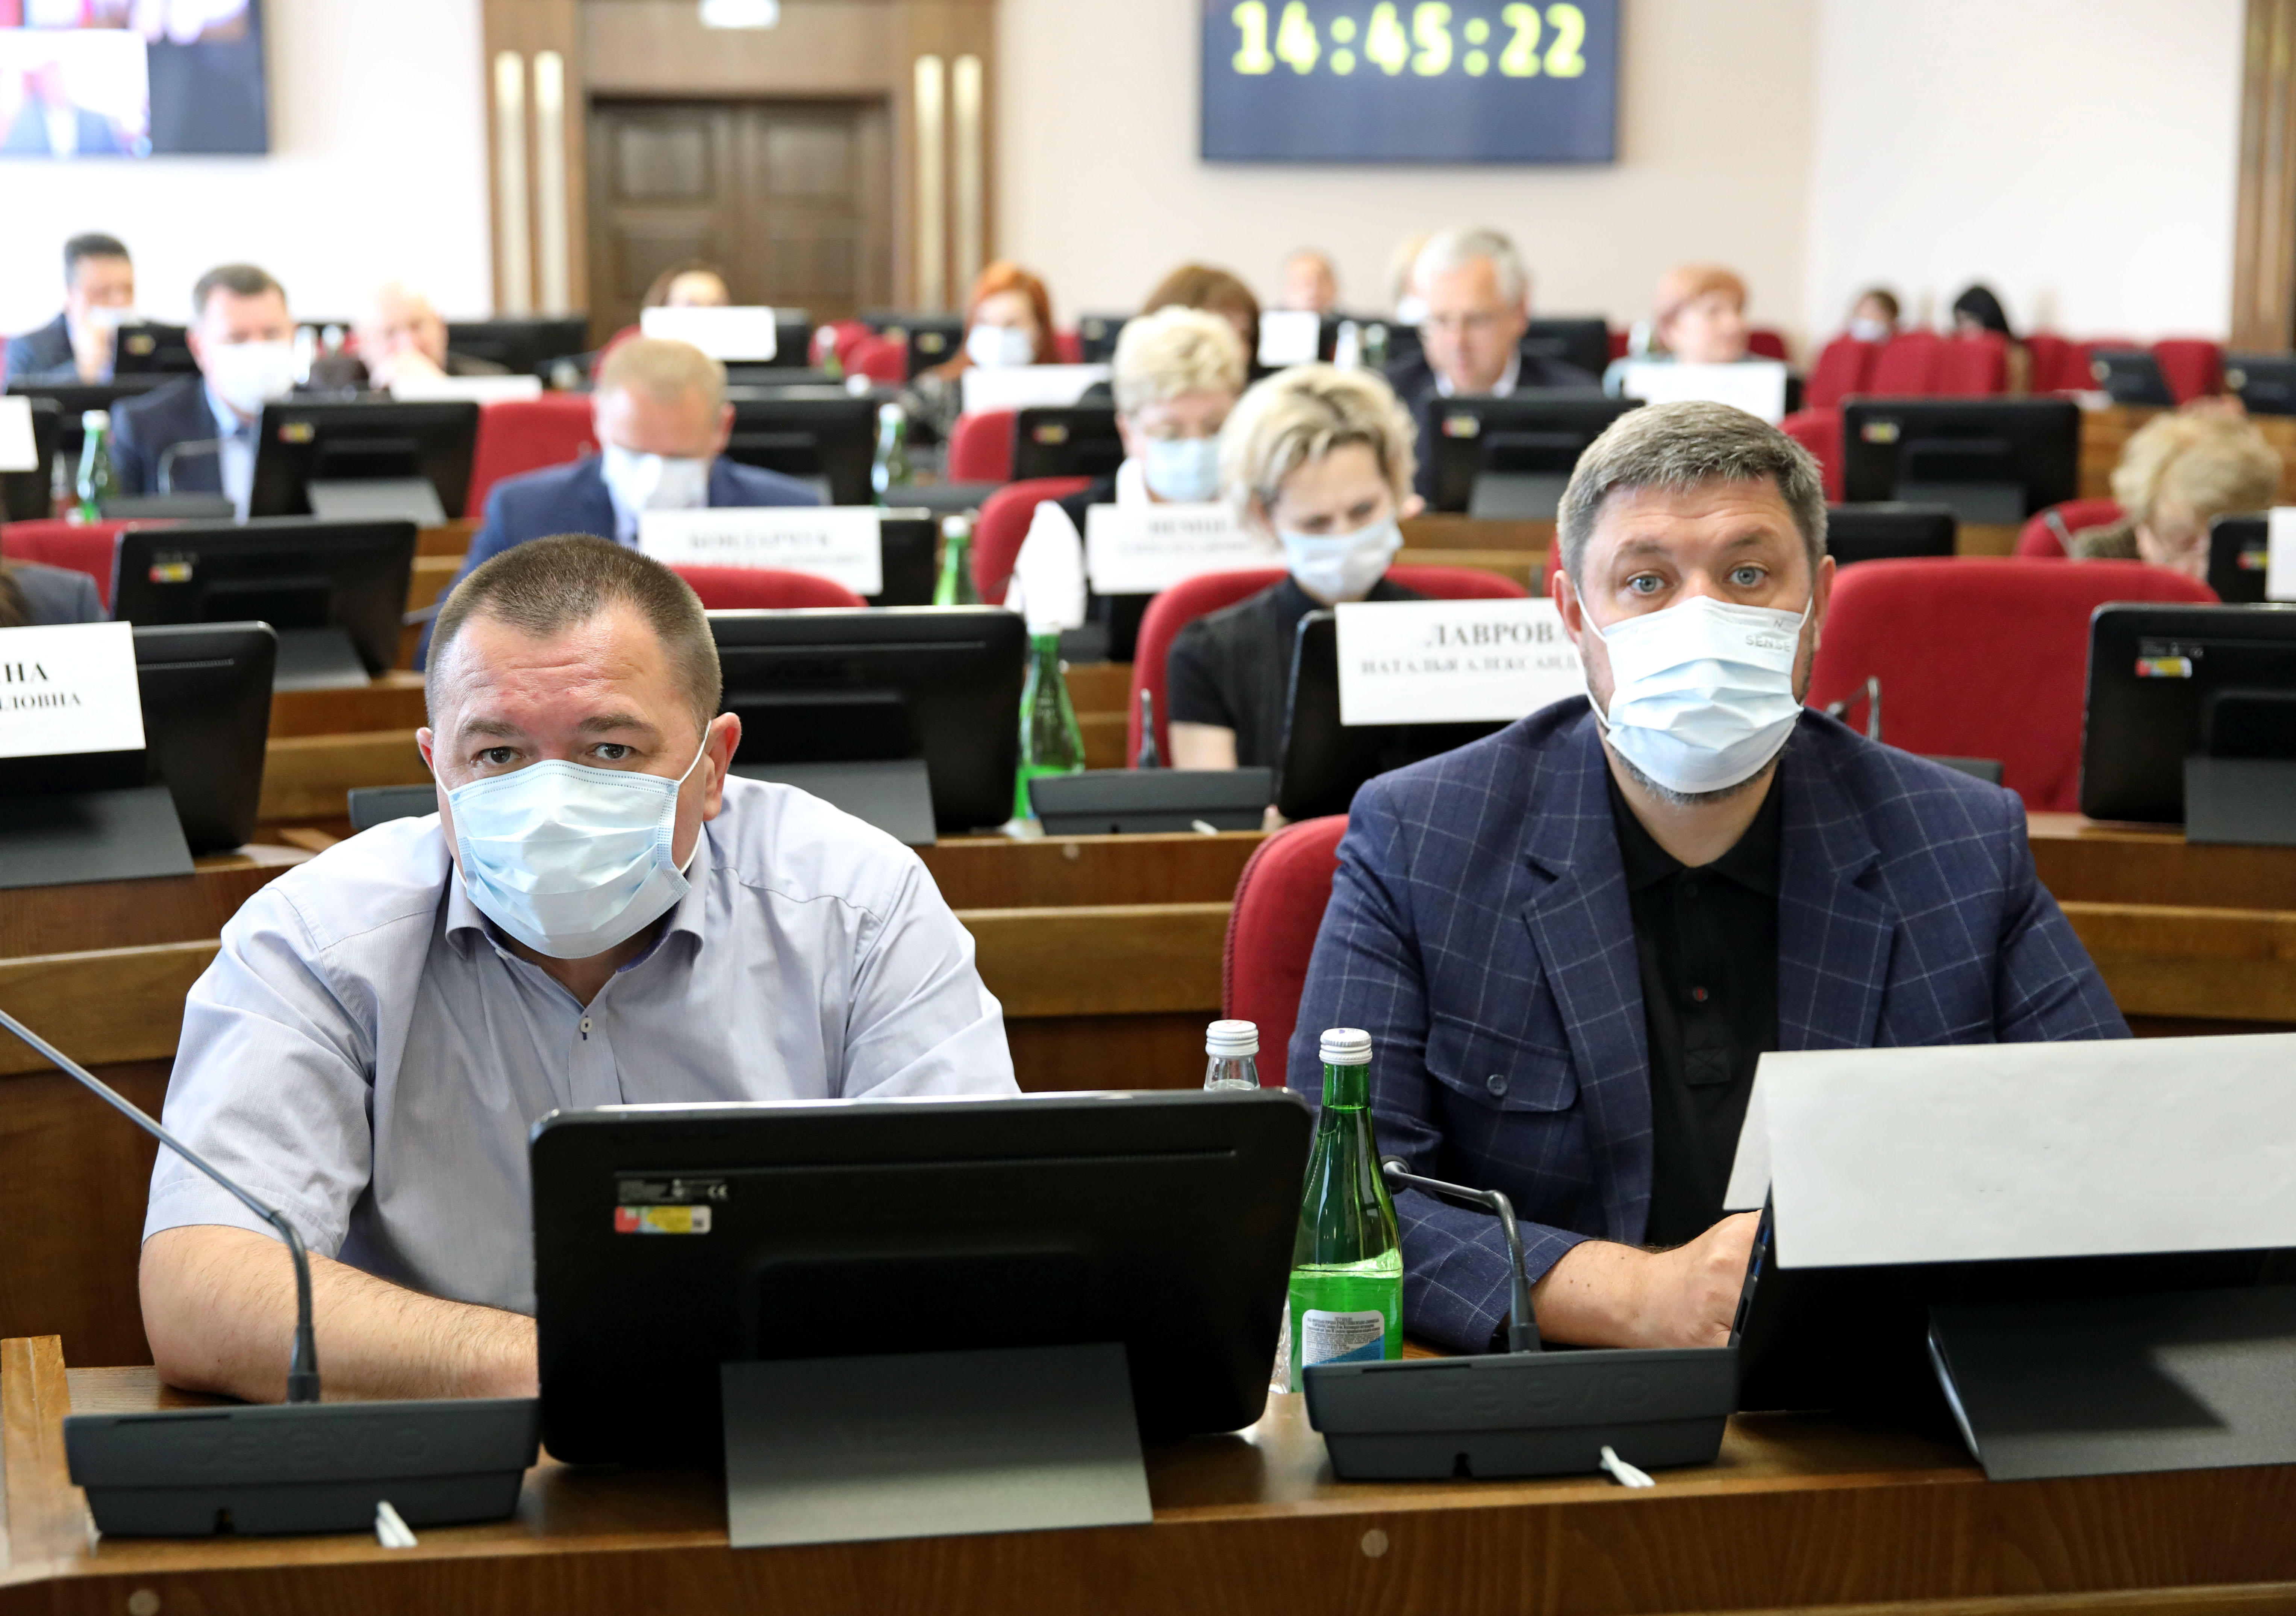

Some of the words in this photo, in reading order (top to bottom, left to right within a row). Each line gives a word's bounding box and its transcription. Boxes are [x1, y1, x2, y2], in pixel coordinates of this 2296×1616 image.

[1231, 0, 1586, 77] 14:45:22
[0, 661, 47, 683] НА
[1361, 658, 1458, 675] НАТАЛЬЯ
[0, 692, 82, 711] ЛОВНА
